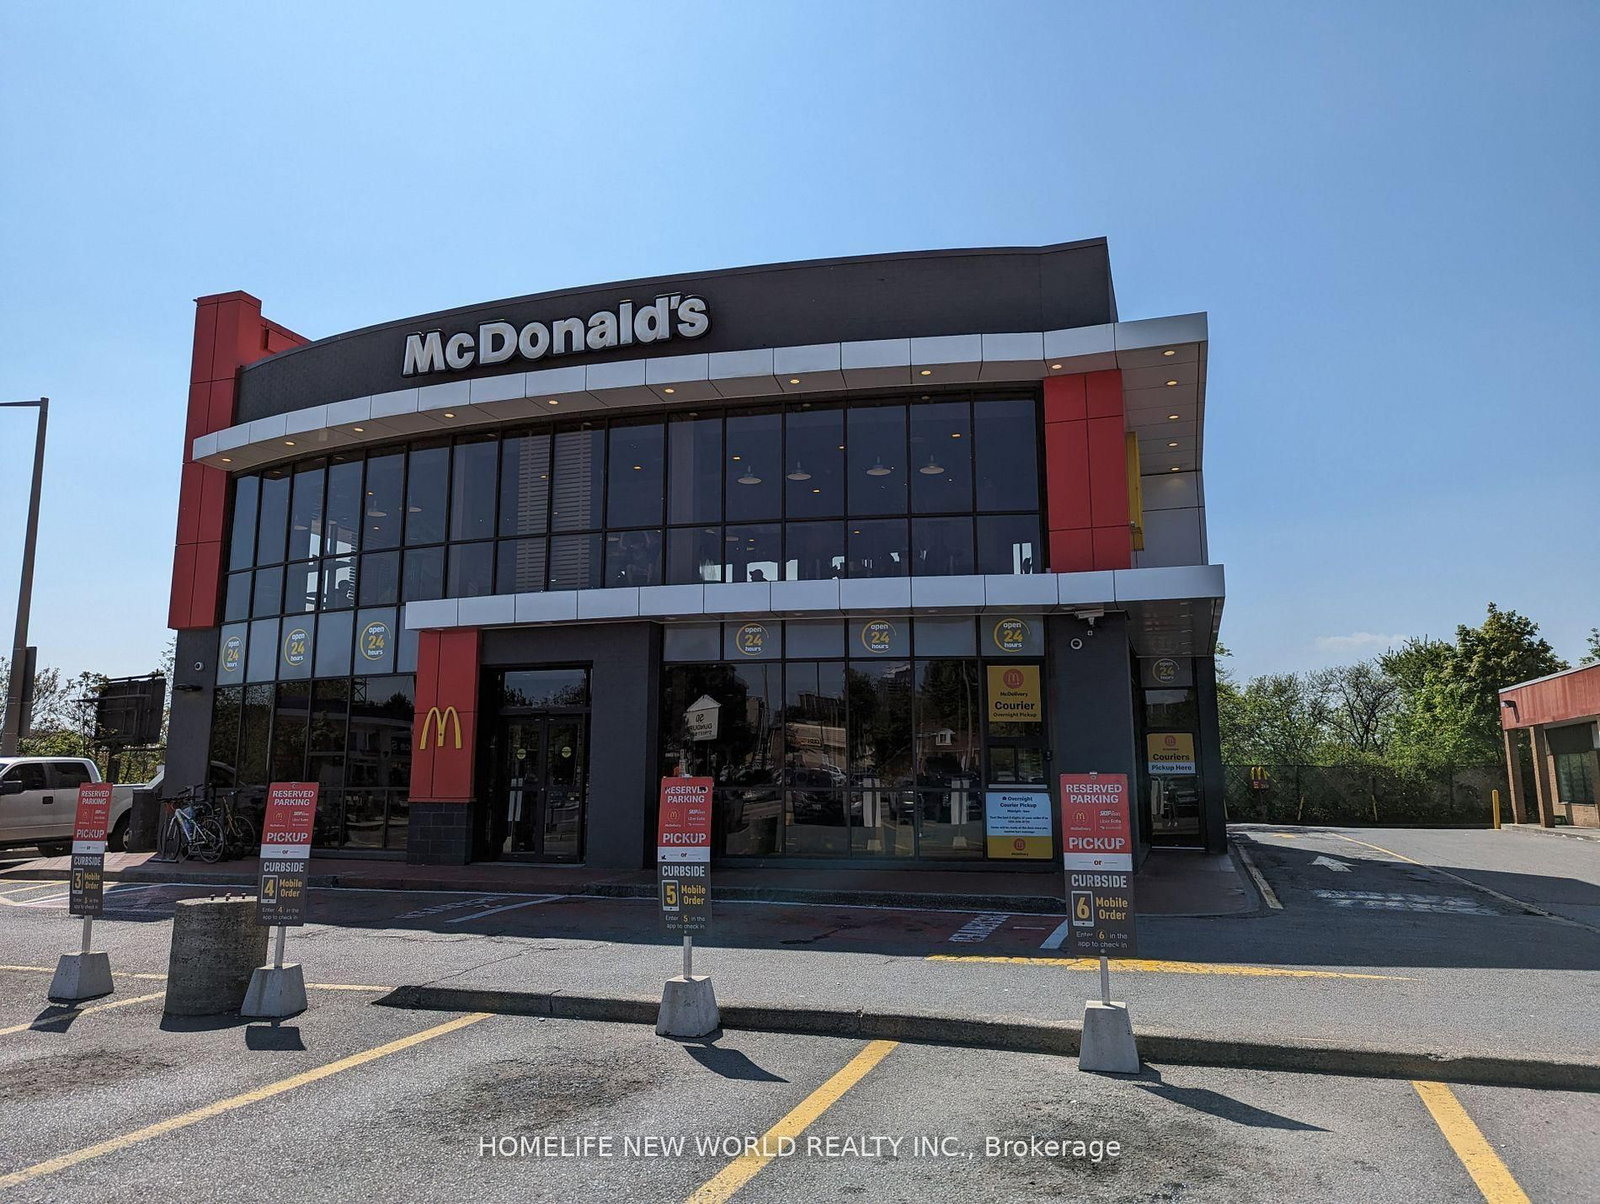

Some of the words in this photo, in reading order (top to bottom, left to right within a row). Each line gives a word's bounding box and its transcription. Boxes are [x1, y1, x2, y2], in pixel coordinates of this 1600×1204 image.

[402, 294, 709, 375] McDonald's
[745, 634, 762, 646] 24
[872, 631, 890, 643] 24
[1004, 630, 1023, 642] 24
[368, 635, 384, 649] 24
[291, 641, 305, 655] 24
[995, 701, 1035, 710] Courier
[1153, 753, 1190, 761] Couriers
[1066, 784, 1122, 793] RESERVED
[81, 790, 110, 798] RESERVED
[272, 790, 315, 798] RESERVED
[667, 795, 705, 803] PARKING
[1070, 795, 1119, 804] PARKING
[76, 829, 105, 838] PICKUP
[266, 832, 308, 842] PICKUP
[662, 832, 707, 844] PICKUP
[1069, 837, 1125, 850] PICKUP
[73, 856, 102, 866] CURBSIDE
[263, 861, 305, 872] CURBSIDE
[662, 865, 705, 877] CURBSIDE
[75, 872, 82, 889] 3
[84, 872, 101, 880] Mobile
[1071, 874, 1127, 888] CURBSIDE
[85, 881, 100, 890] Order
[264, 879, 275, 897] 4
[279, 879, 303, 888] Mobile
[280, 888, 301, 897] Order
[681, 884, 706, 894] Mobile
[666, 885, 677, 905] 5
[683, 895, 705, 905] Order
[1095, 897, 1128, 908] Mobile
[1076, 897, 1090, 919] 6
[683, 914, 689, 922] 5
[1099, 910, 1127, 920] Order
[1098, 931, 1105, 940] 6
[1117, 932, 1128, 940] the
